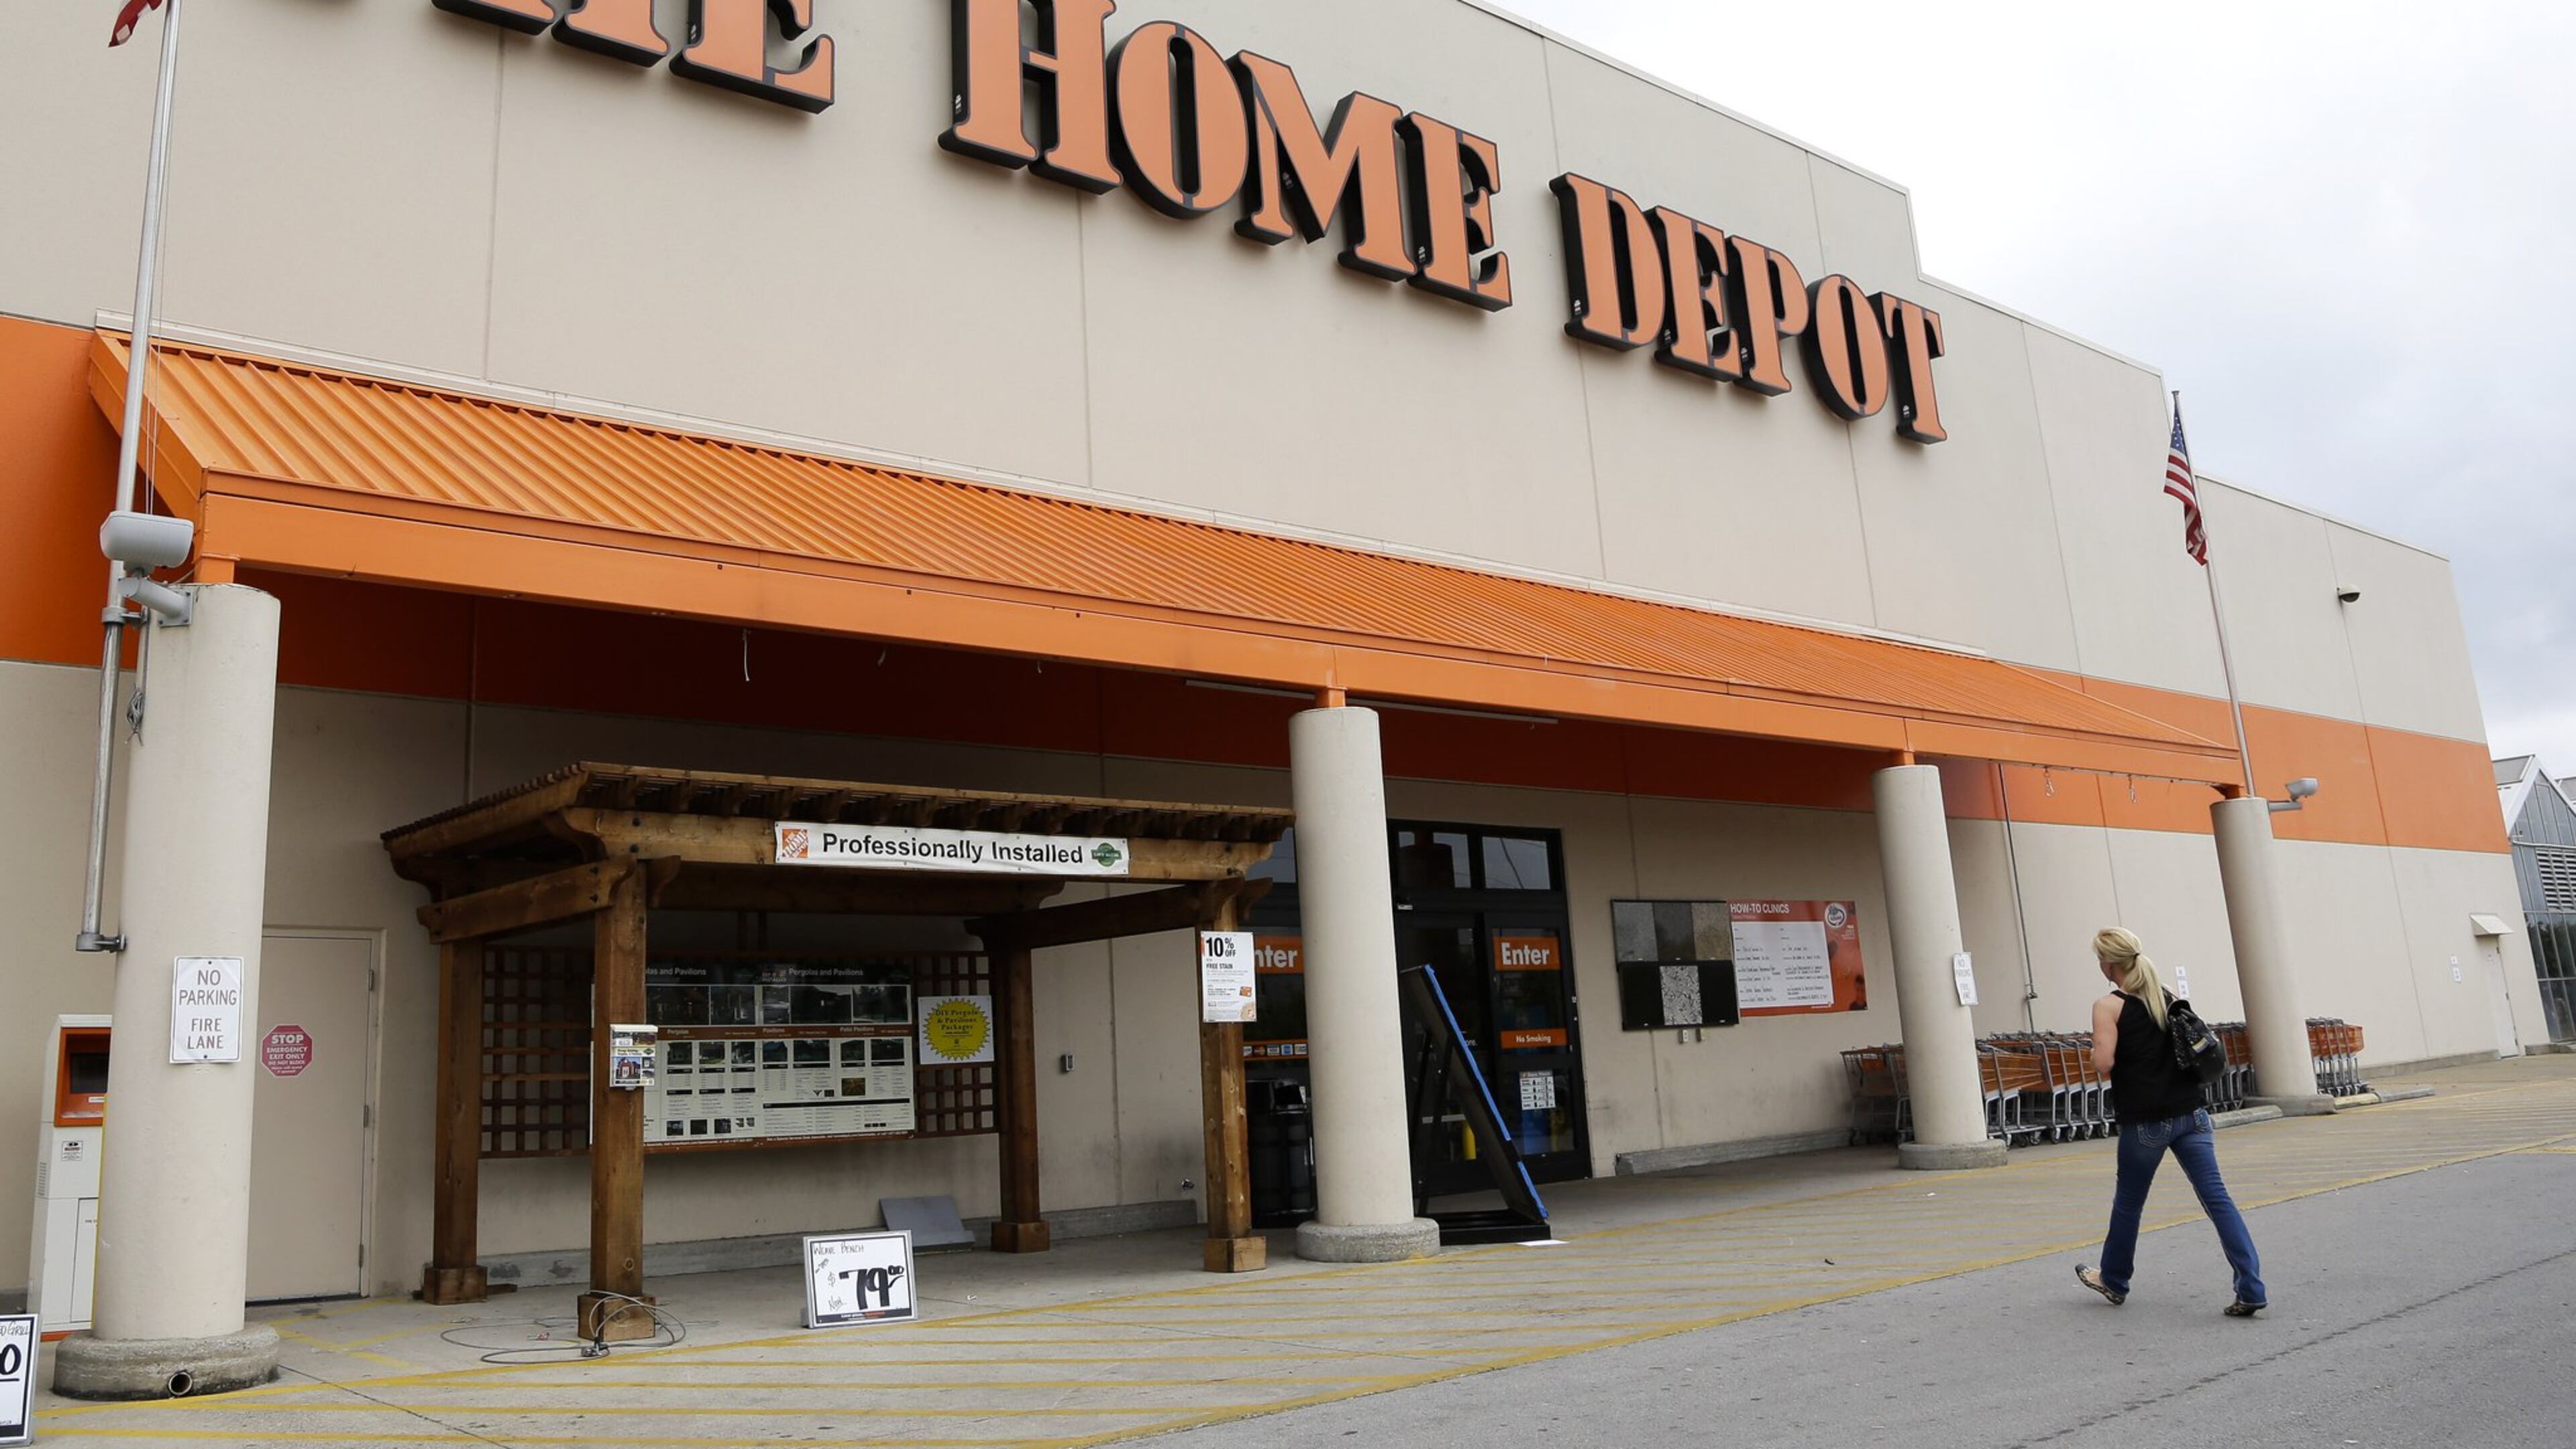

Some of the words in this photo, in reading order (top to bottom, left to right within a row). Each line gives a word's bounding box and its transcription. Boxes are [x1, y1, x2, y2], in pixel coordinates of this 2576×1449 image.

[939, 0, 1513, 312] HOME
[1549, 172, 1947, 444] DEPOT
[822, 833, 983, 863] Professionally
[991, 841, 1083, 864] Installed
[1730, 903, 1761, 913] HOW-TO
[1762, 903, 1790, 914] CLINICS
[1225, 949, 1236, 957] OFF
[1255, 945, 1298, 968] nter
[1501, 942, 1550, 965] Enter
[197, 969, 221, 985] NO
[675, 967, 707, 975] Pavilions
[788, 968, 818, 977] Pergolas
[834, 968, 864, 976] Pavilions
[179, 989, 237, 1006] PARKING
[191, 1018, 222, 1032] FIRE
[187, 1035, 223, 1049] LANE
[271, 1034, 304, 1044] STOP
[1526, 1034, 1552, 1044] Smoking
